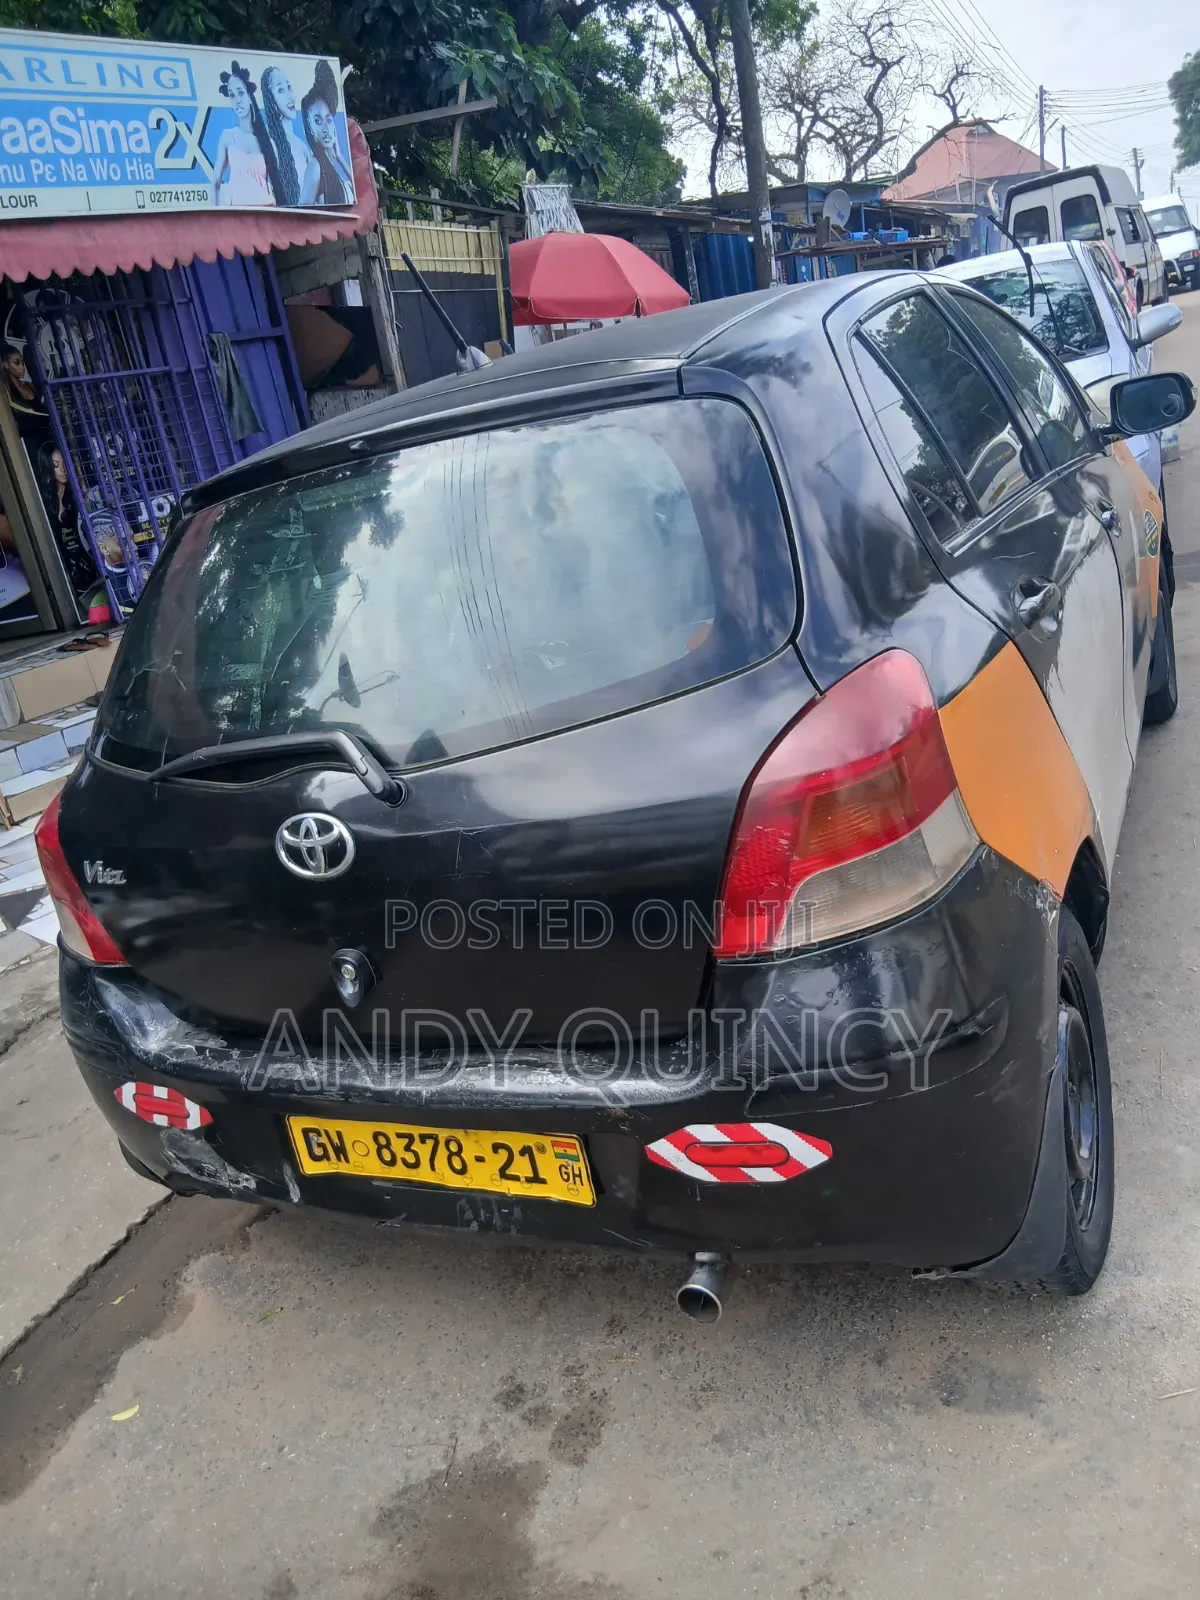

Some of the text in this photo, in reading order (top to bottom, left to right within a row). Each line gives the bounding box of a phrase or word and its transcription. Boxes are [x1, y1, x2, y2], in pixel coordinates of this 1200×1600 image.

[60, 158, 88, 182] Na
[89, 157, 121, 182] Wo
[125, 157, 155, 181] Hia
[149, 190, 208, 203] 0277412750
[84, 860, 127, 884] Vitz
[301, 1127, 548, 1185] GW 8378-21
[558, 1163, 584, 1187] GH
